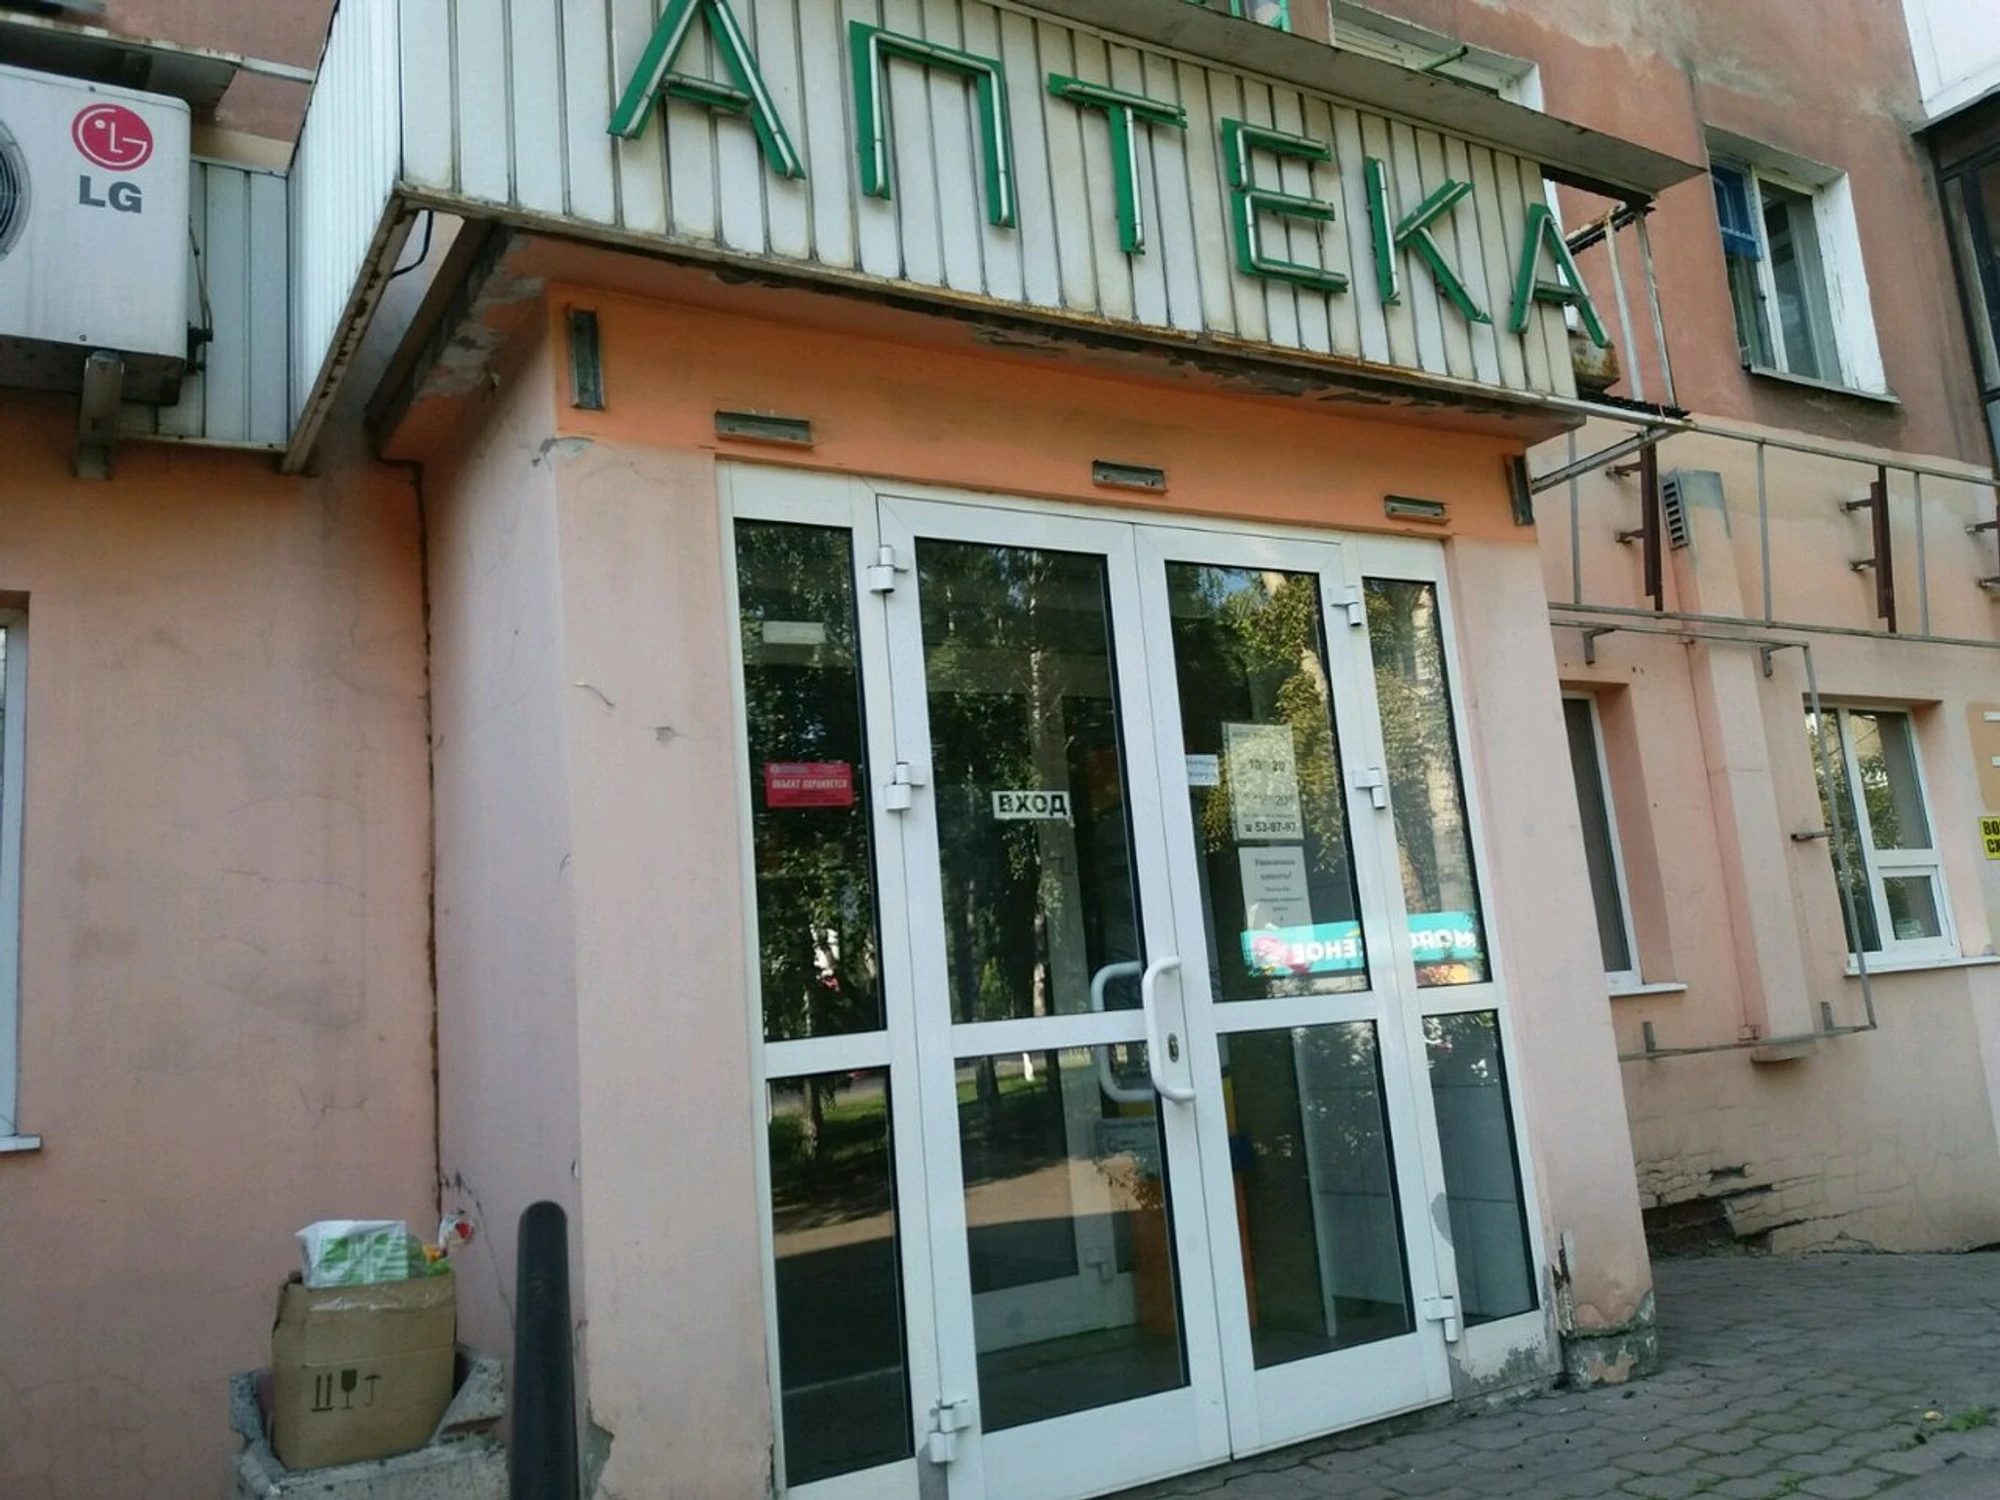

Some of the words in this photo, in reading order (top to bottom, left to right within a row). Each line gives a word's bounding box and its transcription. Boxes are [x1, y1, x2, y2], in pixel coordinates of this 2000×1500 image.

[79, 174, 142, 213] LG
[606, 0, 1612, 349] АПТЕКА
[998, 793, 1067, 816] ВХОД
